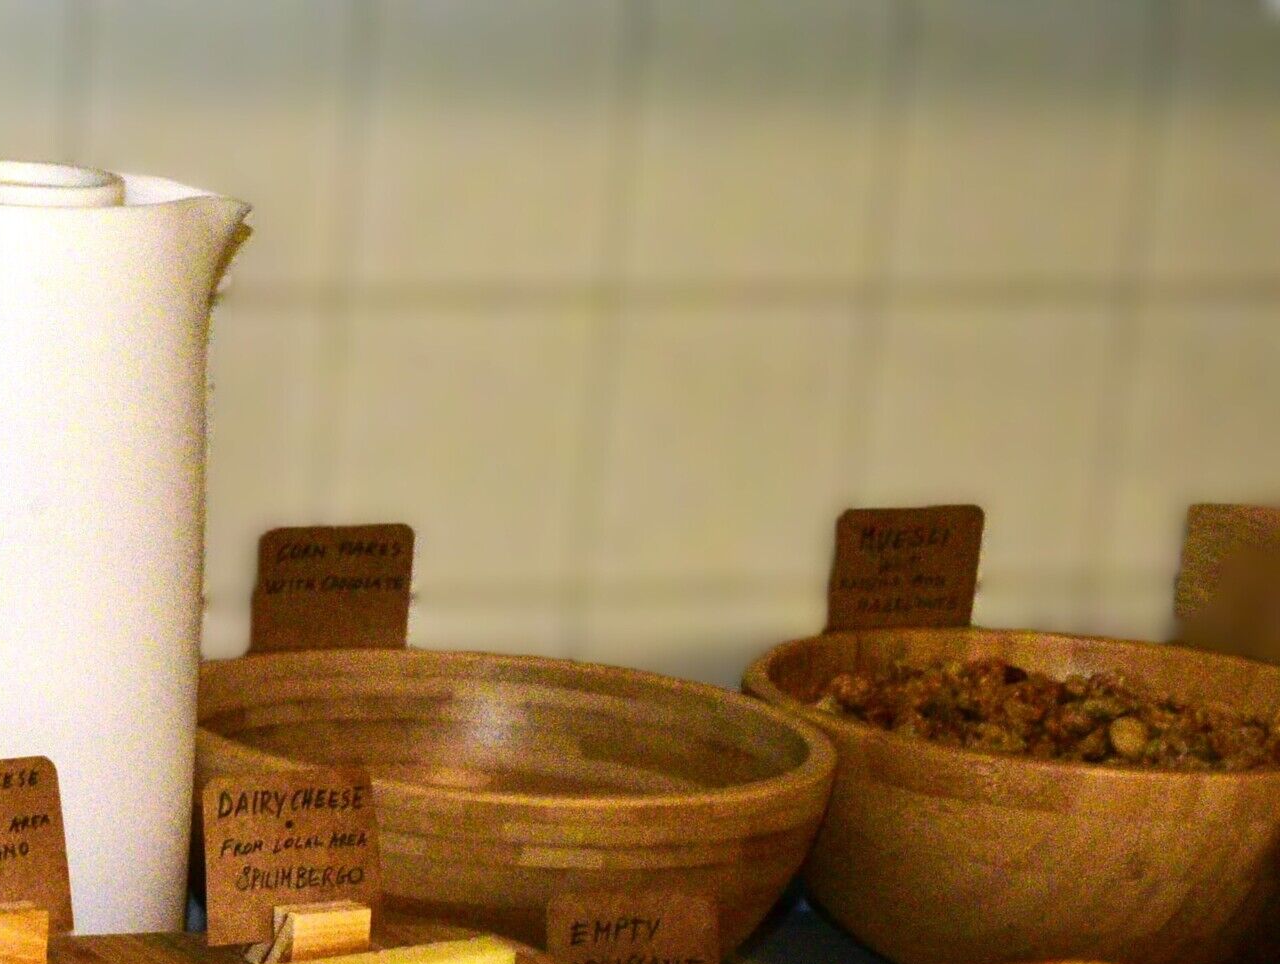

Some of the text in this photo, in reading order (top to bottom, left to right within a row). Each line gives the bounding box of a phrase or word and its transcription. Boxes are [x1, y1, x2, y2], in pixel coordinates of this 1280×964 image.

[217, 785, 365, 820] DAIRY CHEESE
[8, 812, 51, 834] AREA
[219, 831, 367, 859] FROM LOCAL AREA
[236, 864, 366, 892] SPILIMBERGO
[570, 916, 662, 946] EMPTY
